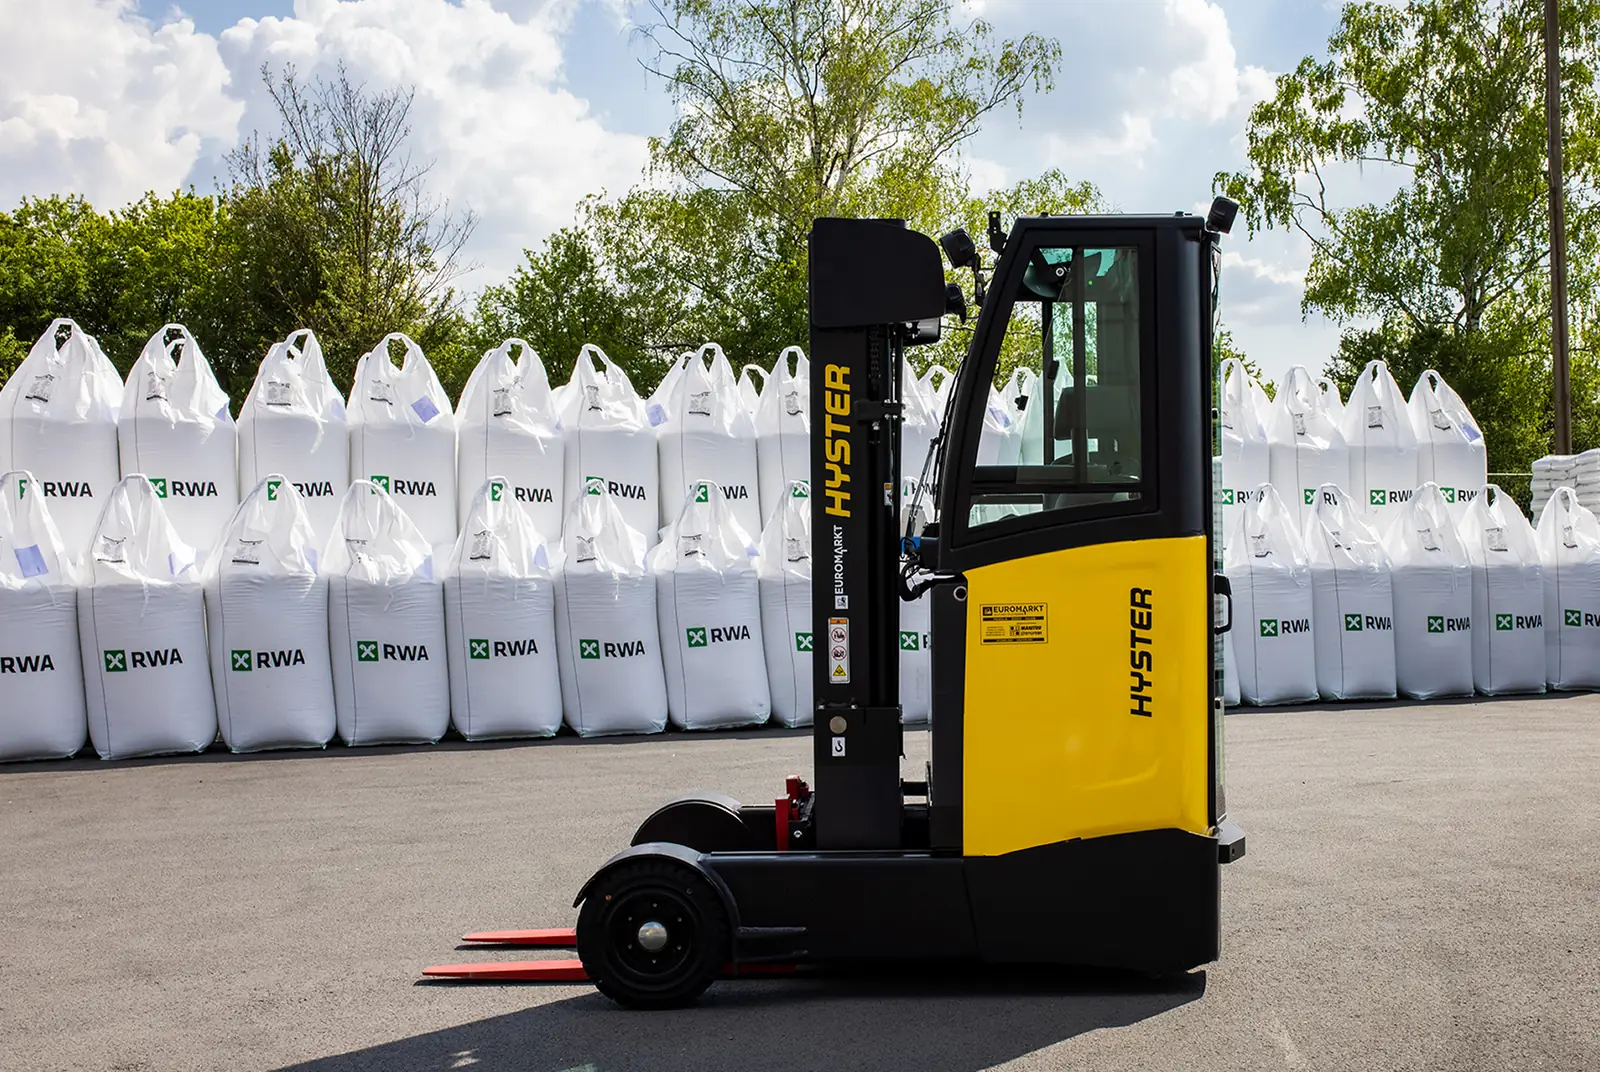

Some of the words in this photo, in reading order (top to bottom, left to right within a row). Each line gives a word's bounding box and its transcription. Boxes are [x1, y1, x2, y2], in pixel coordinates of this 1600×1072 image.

[825, 363, 851, 518] HYSTER
[43, 481, 93, 498] RWA
[171, 480, 218, 497] RWA
[394, 479, 437, 497] RWA
[515, 487, 553, 503] RWA
[608, 480, 646, 501] RWA
[719, 485, 749, 500] WA
[1458, 489, 1478, 502] RW
[833, 524, 848, 595] EUROMARKT
[993, 604, 1045, 615] EUROMARKT
[1281, 618, 1311, 634] RWA
[1365, 615, 1392, 631] RWA
[1446, 616, 1471, 632] RWA
[1515, 614, 1543, 630] RWA
[710, 625, 751, 643] RWA
[383, 642, 429, 662] RWA
[493, 638, 539, 658] RWA
[603, 640, 646, 658] RWA
[1130, 587, 1152, 718] HYSTER
[0, 654, 55, 674] RWA
[130, 648, 184, 669] RWA
[256, 648, 306, 669] RWA
